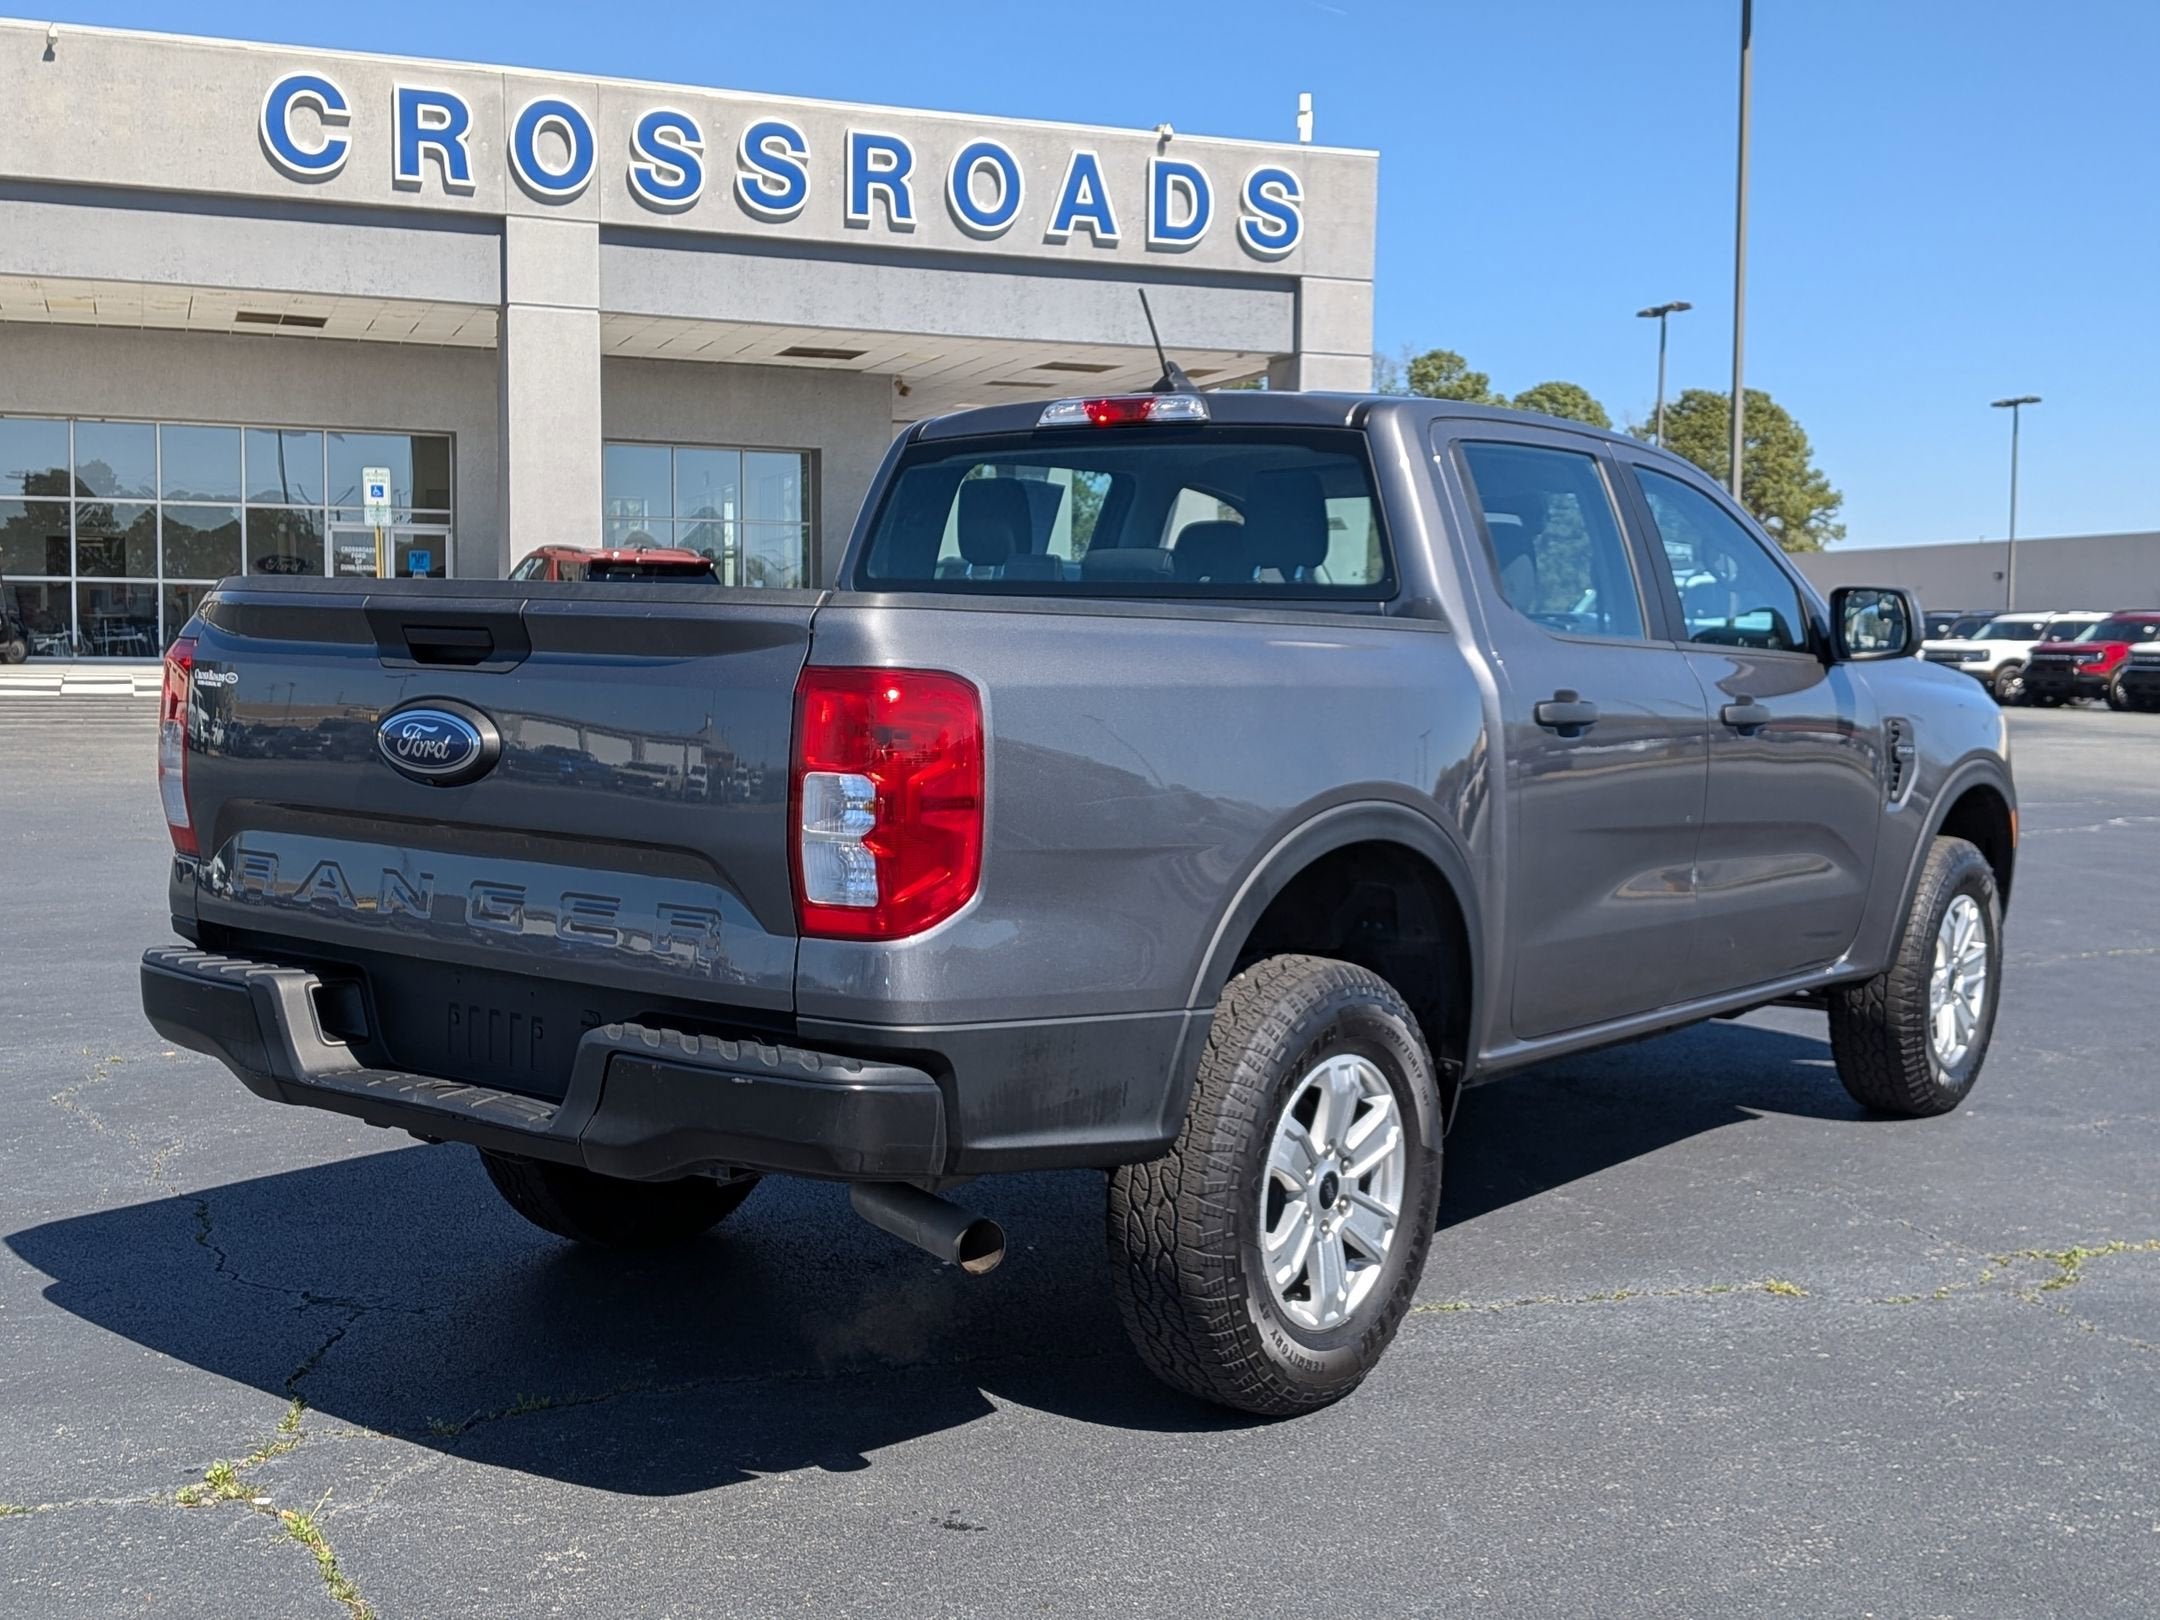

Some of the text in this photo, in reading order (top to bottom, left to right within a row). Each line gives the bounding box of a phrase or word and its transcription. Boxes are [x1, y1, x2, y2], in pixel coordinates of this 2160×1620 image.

[260, 70, 1306, 261] CROSSROADS
[397, 722, 452, 760] Ford
[233, 848, 723, 962] RANGER
[1269, 1329, 1326, 1374] TERRITORY
